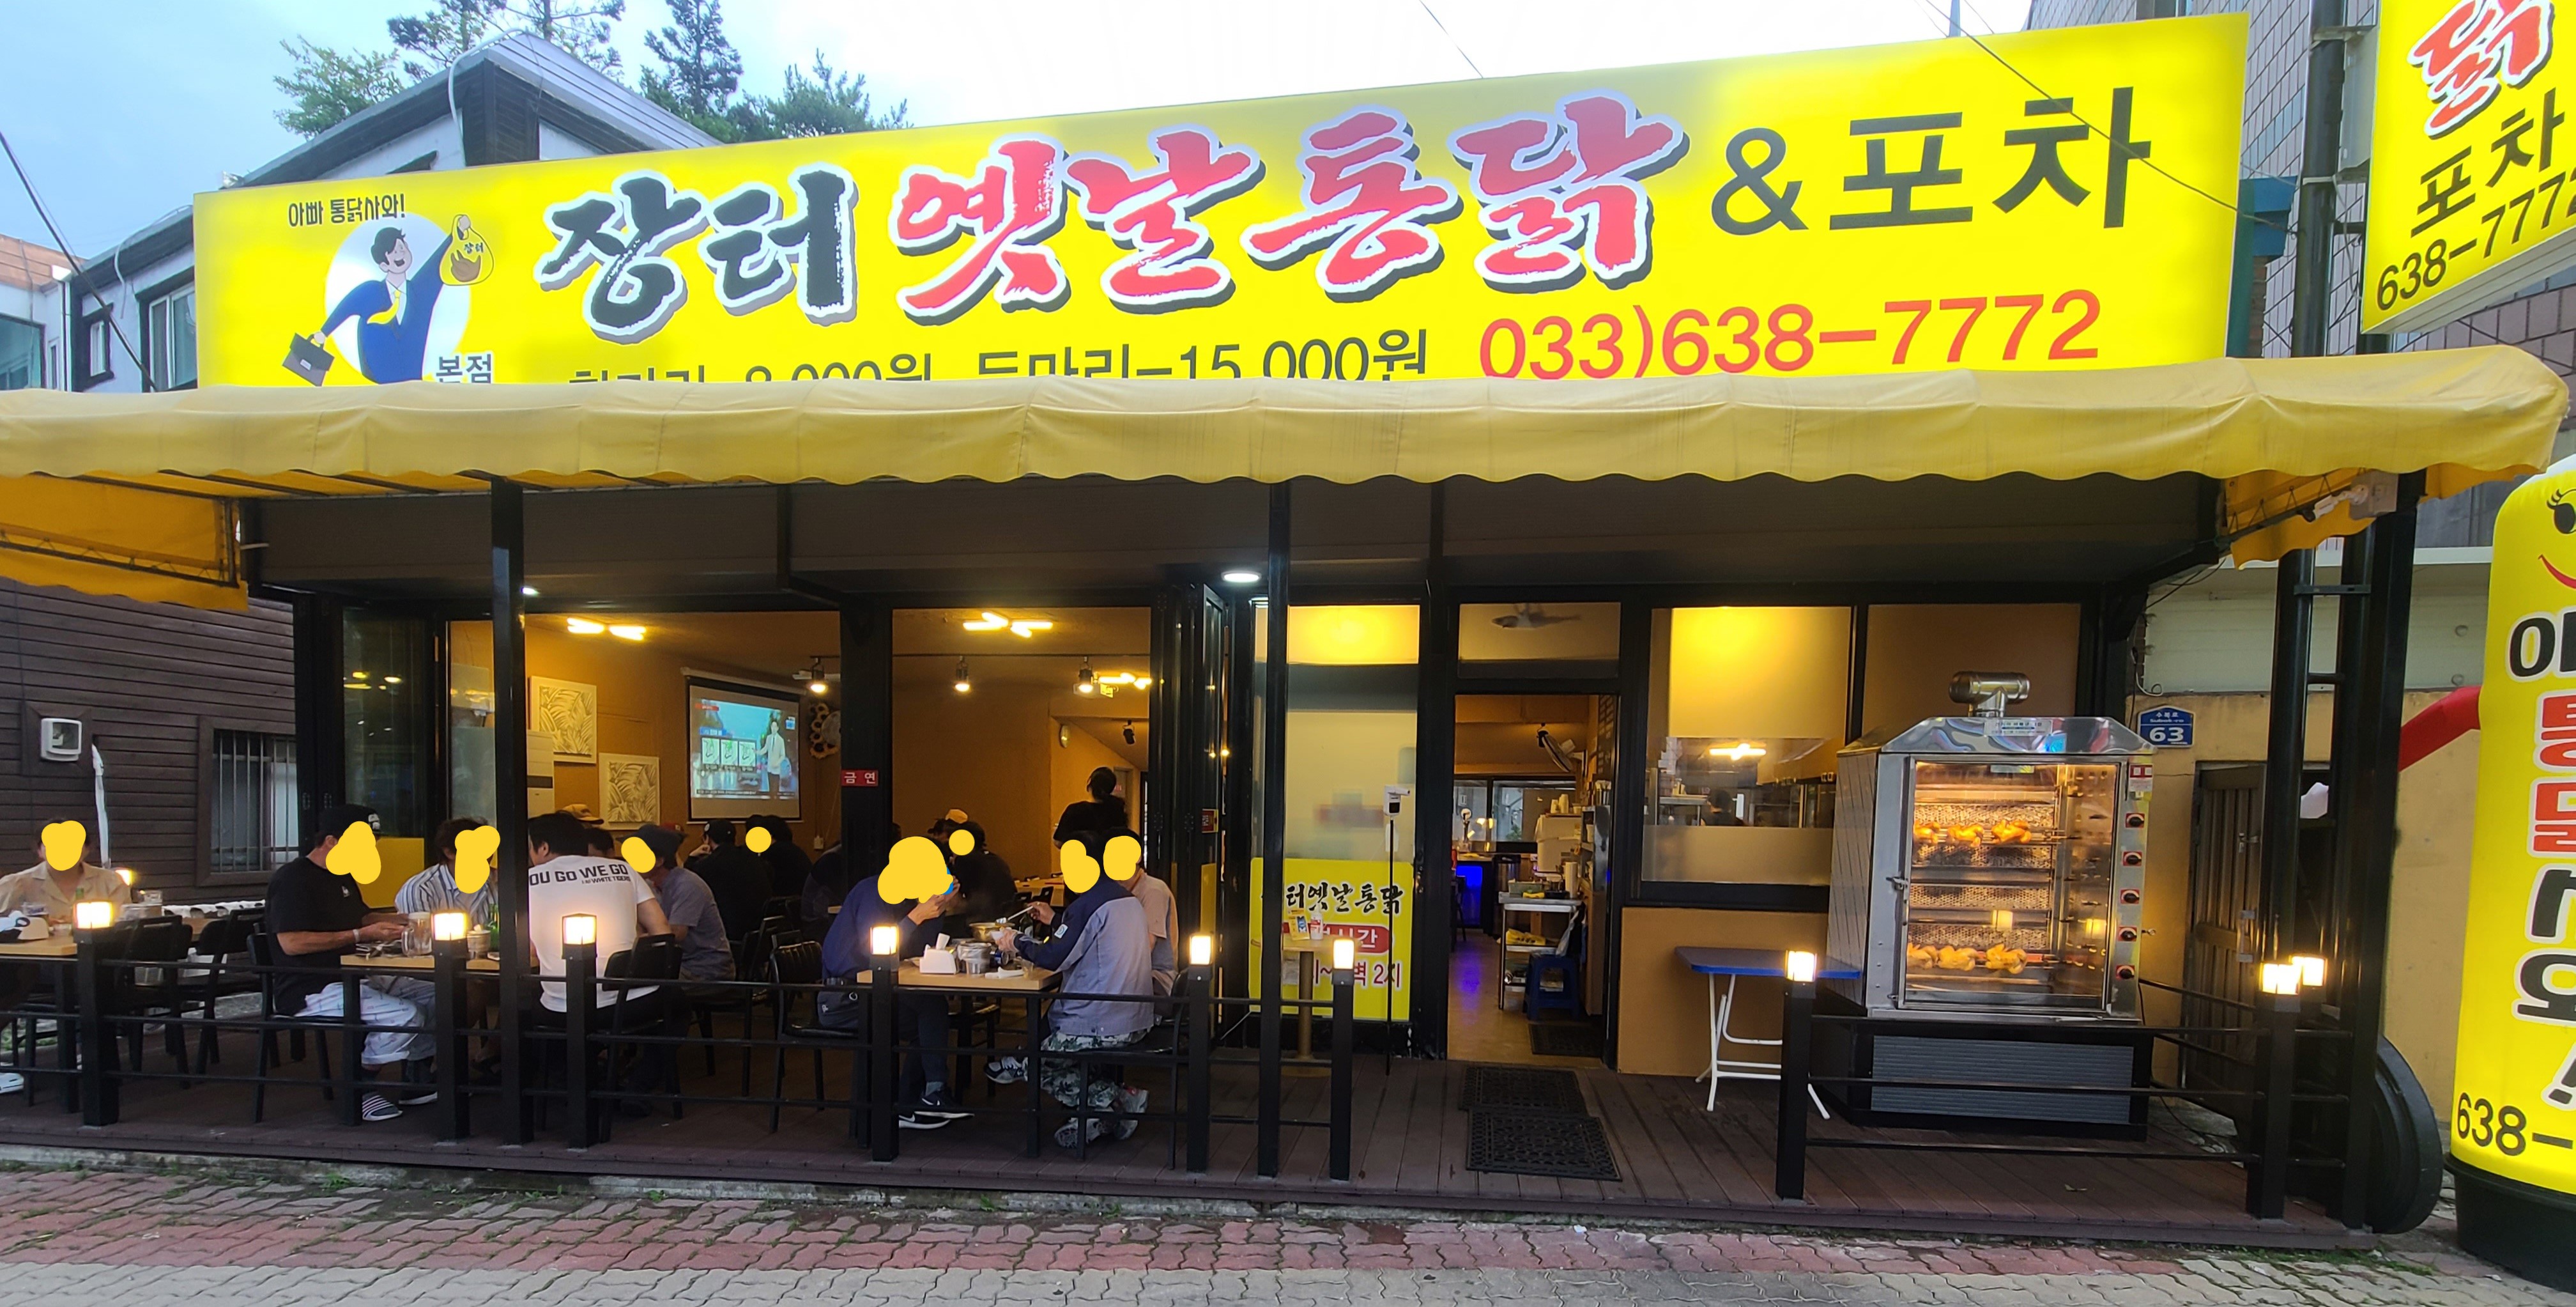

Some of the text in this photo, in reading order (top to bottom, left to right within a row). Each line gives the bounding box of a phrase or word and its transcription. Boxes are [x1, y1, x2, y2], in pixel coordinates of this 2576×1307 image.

[2410, 88, 2565, 238] 포차
[289, 194, 405, 227] 아빠 통닭사와!
[535, 165, 854, 341] 장터
[890, 91, 1685, 323] 옛날통닭
[464, 242, 484, 254] 장터
[1480, 290, 2101, 380] 033)638-7772
[436, 354, 492, 384] 본점
[2149, 727, 2184, 741] 63
[529, 871, 551, 886] OU
[555, 871, 577, 882] GO
[579, 865, 608, 878] WE
[609, 864, 628, 875] GO
[1262, 881, 1404, 915] 터옛날통닭
